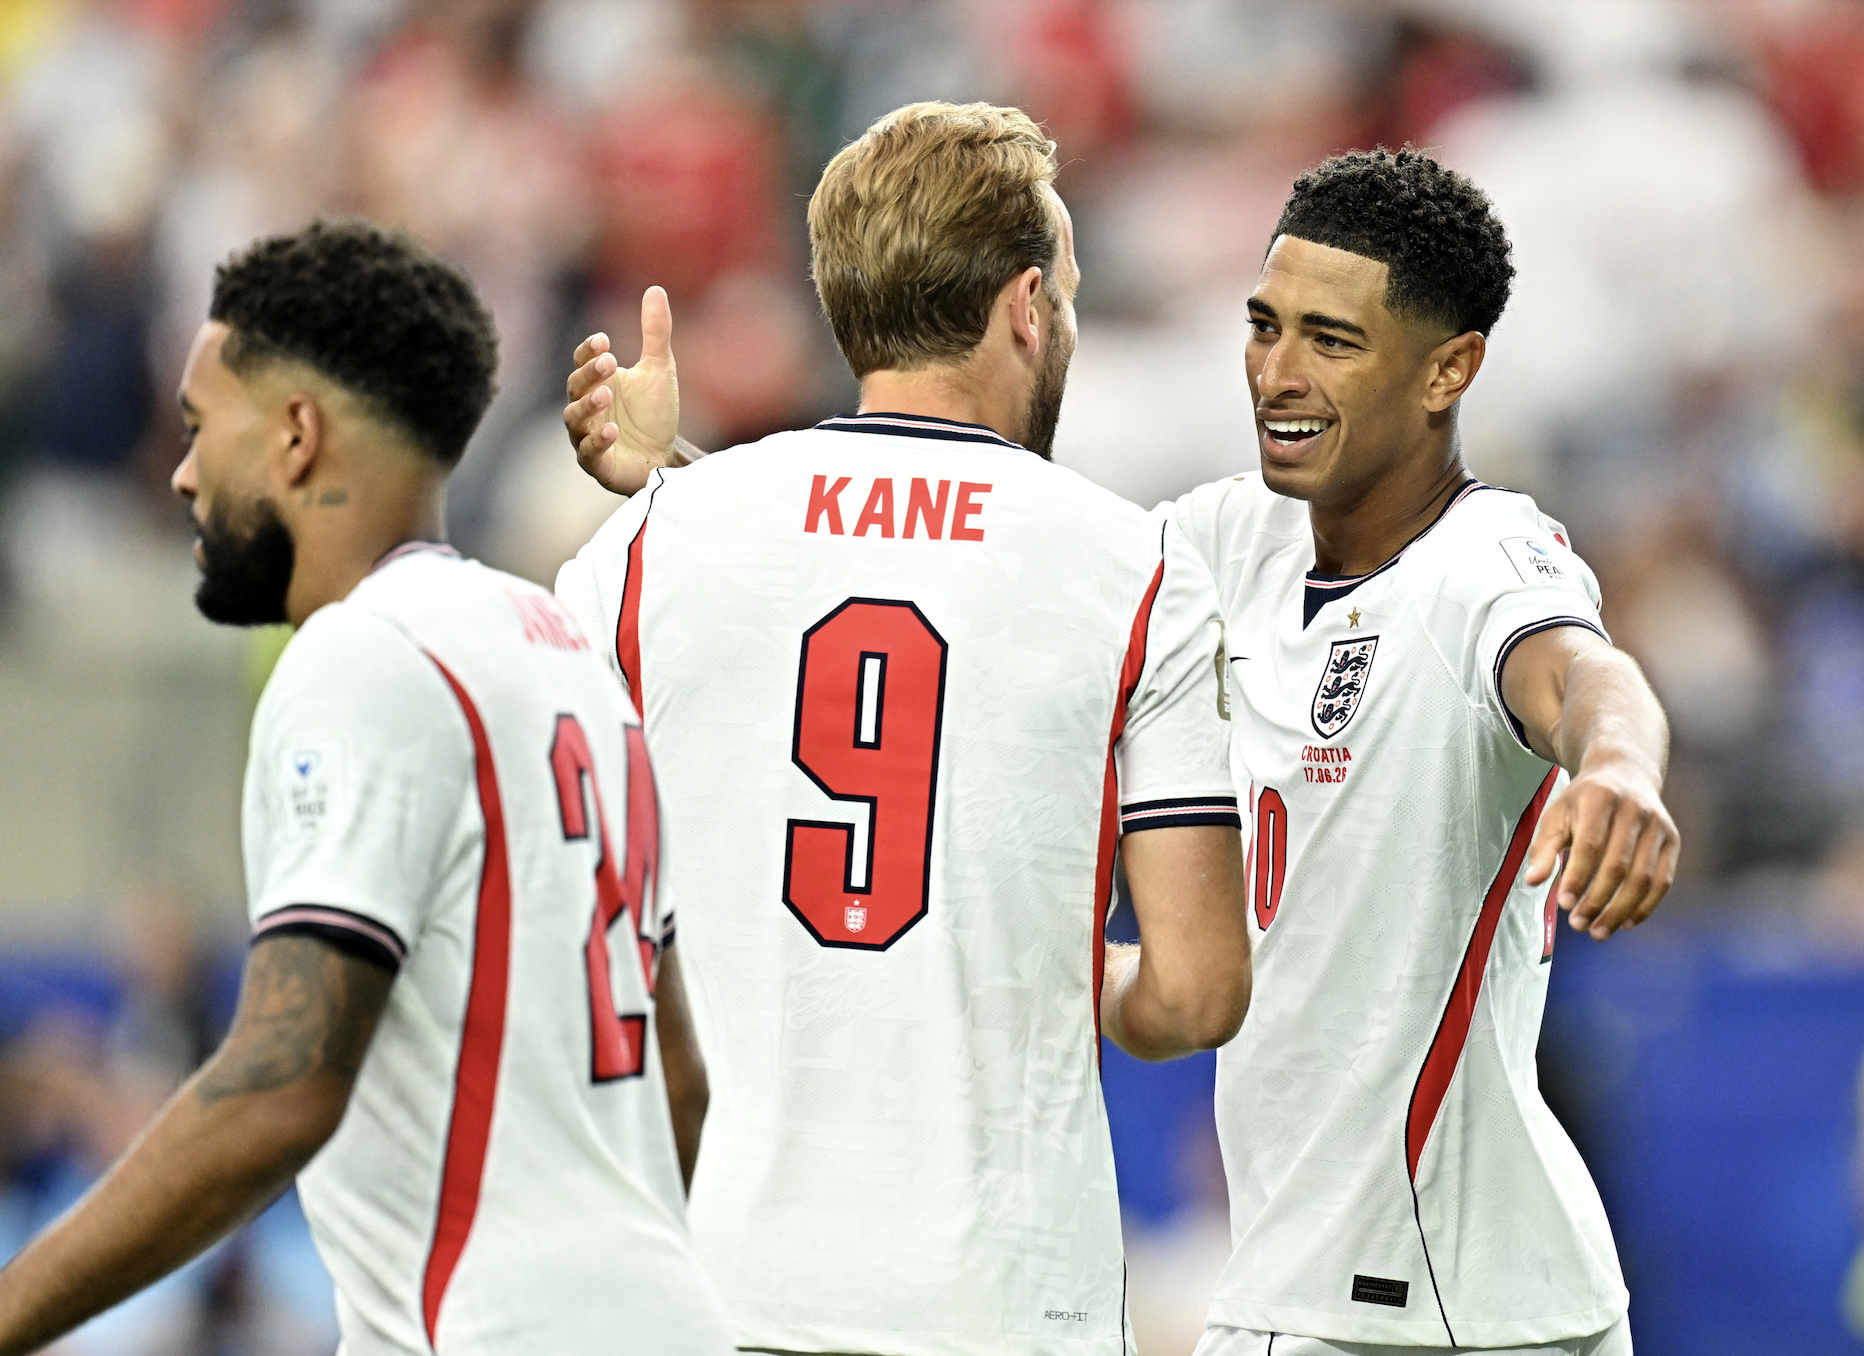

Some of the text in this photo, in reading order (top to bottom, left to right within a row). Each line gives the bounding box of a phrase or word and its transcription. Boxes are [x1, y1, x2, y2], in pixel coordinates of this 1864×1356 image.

[804, 474, 993, 542] KANE
[782, 596, 948, 951] 9
[1301, 745, 1352, 763] CROATIA
[1304, 766, 1347, 783] 17.06.26
[1245, 780, 1287, 931] 0
[549, 713, 660, 1083] 24
[1044, 1310, 1088, 1321] AERO-FIT
